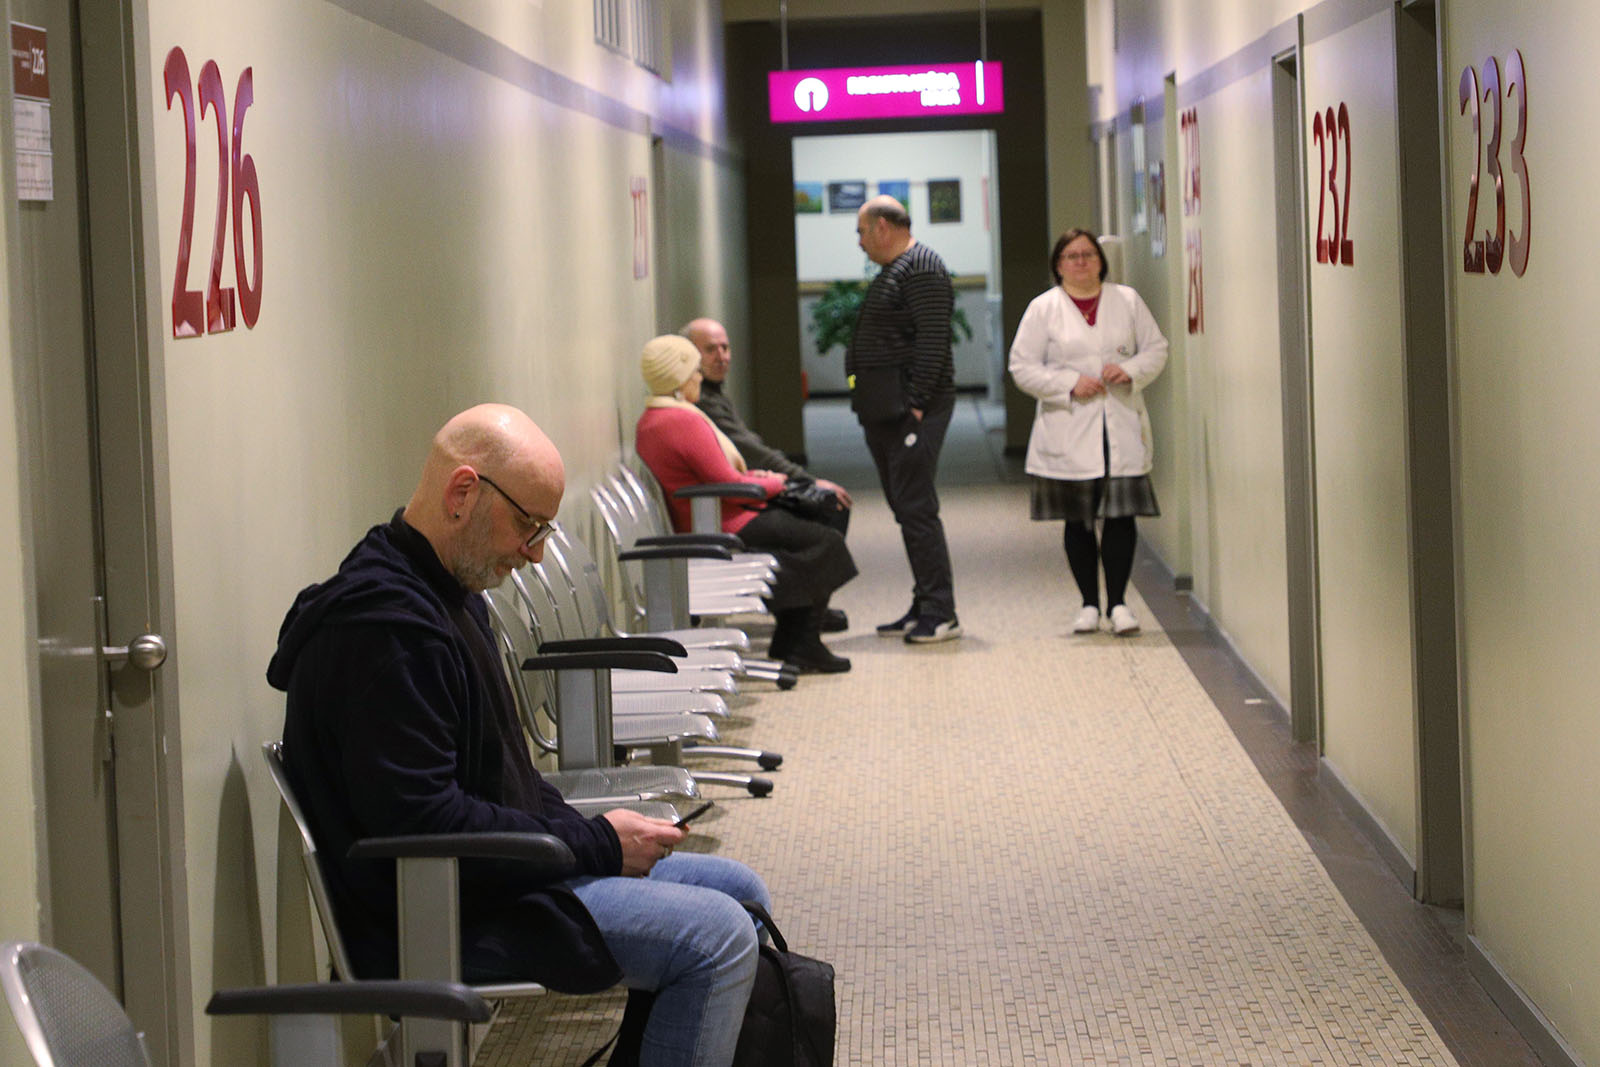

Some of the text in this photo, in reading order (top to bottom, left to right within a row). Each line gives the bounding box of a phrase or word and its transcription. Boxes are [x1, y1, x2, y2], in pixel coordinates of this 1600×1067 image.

[31, 48, 45, 75] 226
[164, 45, 263, 337] 226
[1313, 101, 1354, 267] 232
[1459, 48, 1531, 278] 233
